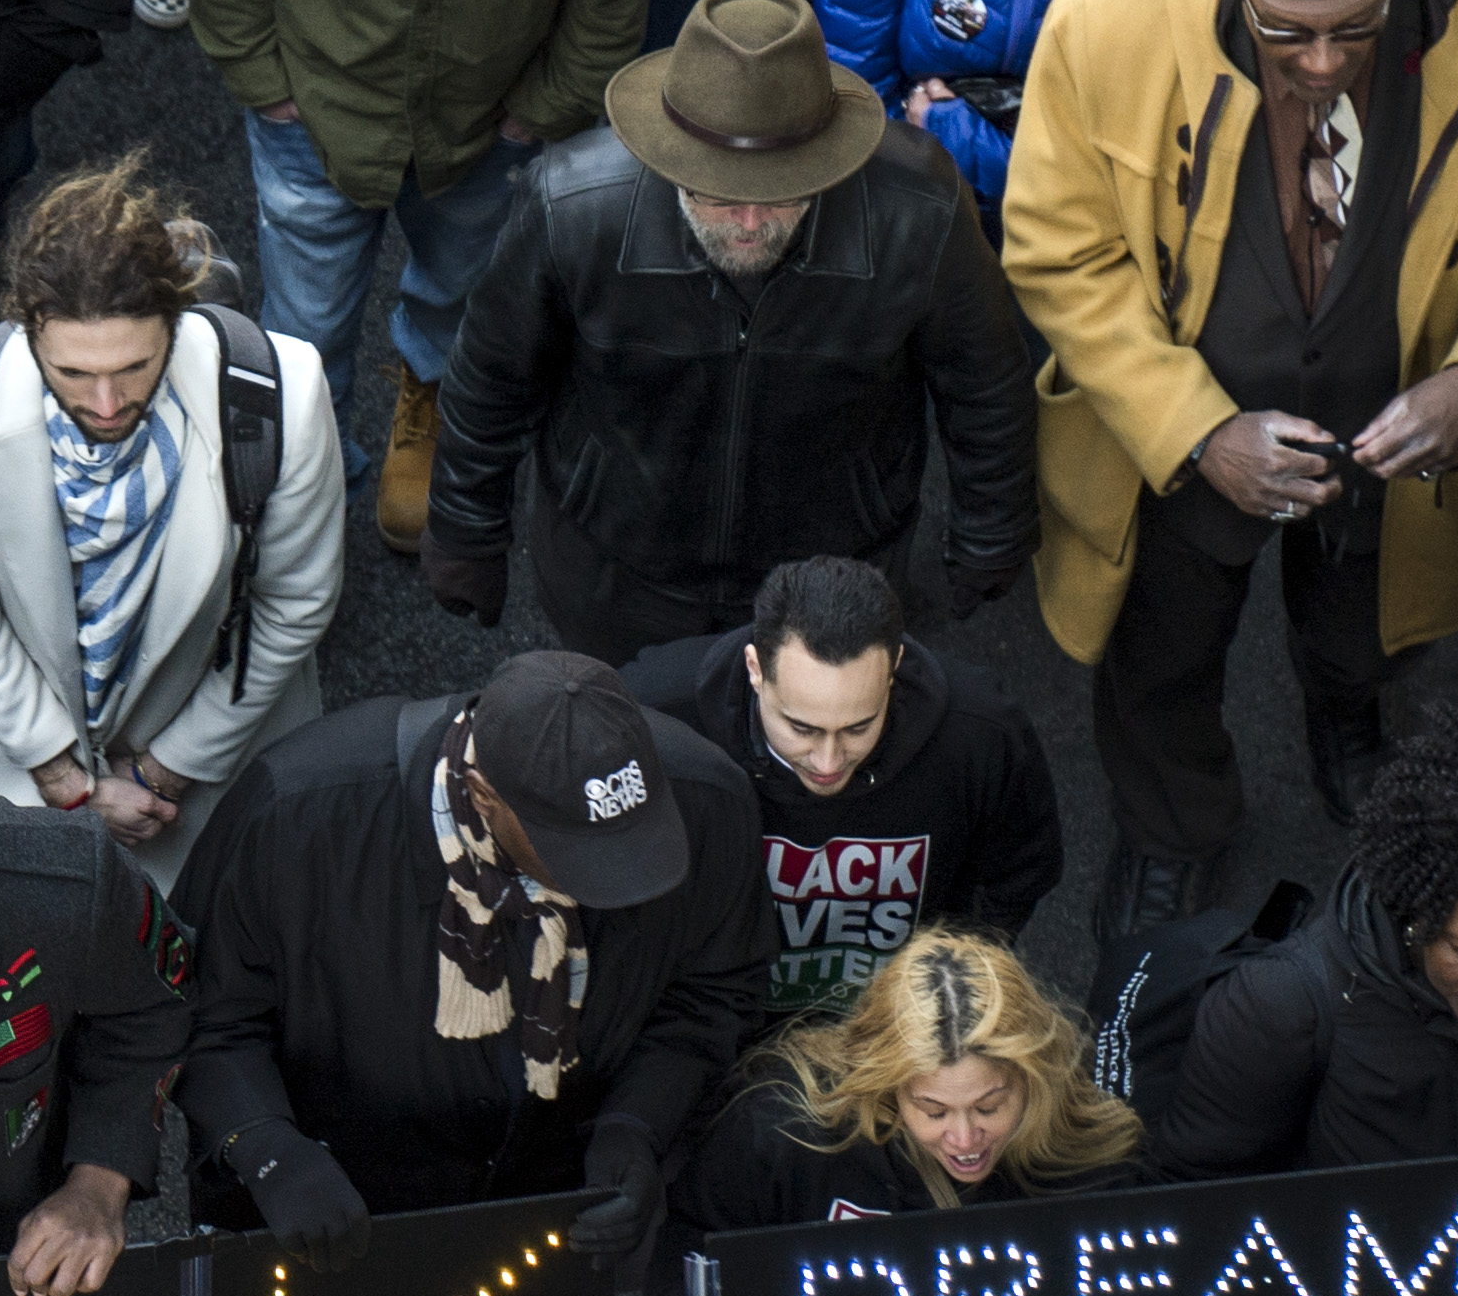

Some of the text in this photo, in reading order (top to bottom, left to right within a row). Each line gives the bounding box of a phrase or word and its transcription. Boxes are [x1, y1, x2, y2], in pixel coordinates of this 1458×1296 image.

[585, 781, 648, 822] NEWS
[605, 759, 644, 797] CBS
[767, 842, 922, 898] LACK
[773, 900, 913, 951] VES
[769, 948, 890, 986] TTE
[1108, 970, 1144, 1083] importance
[1094, 1029, 1110, 1091] librar
